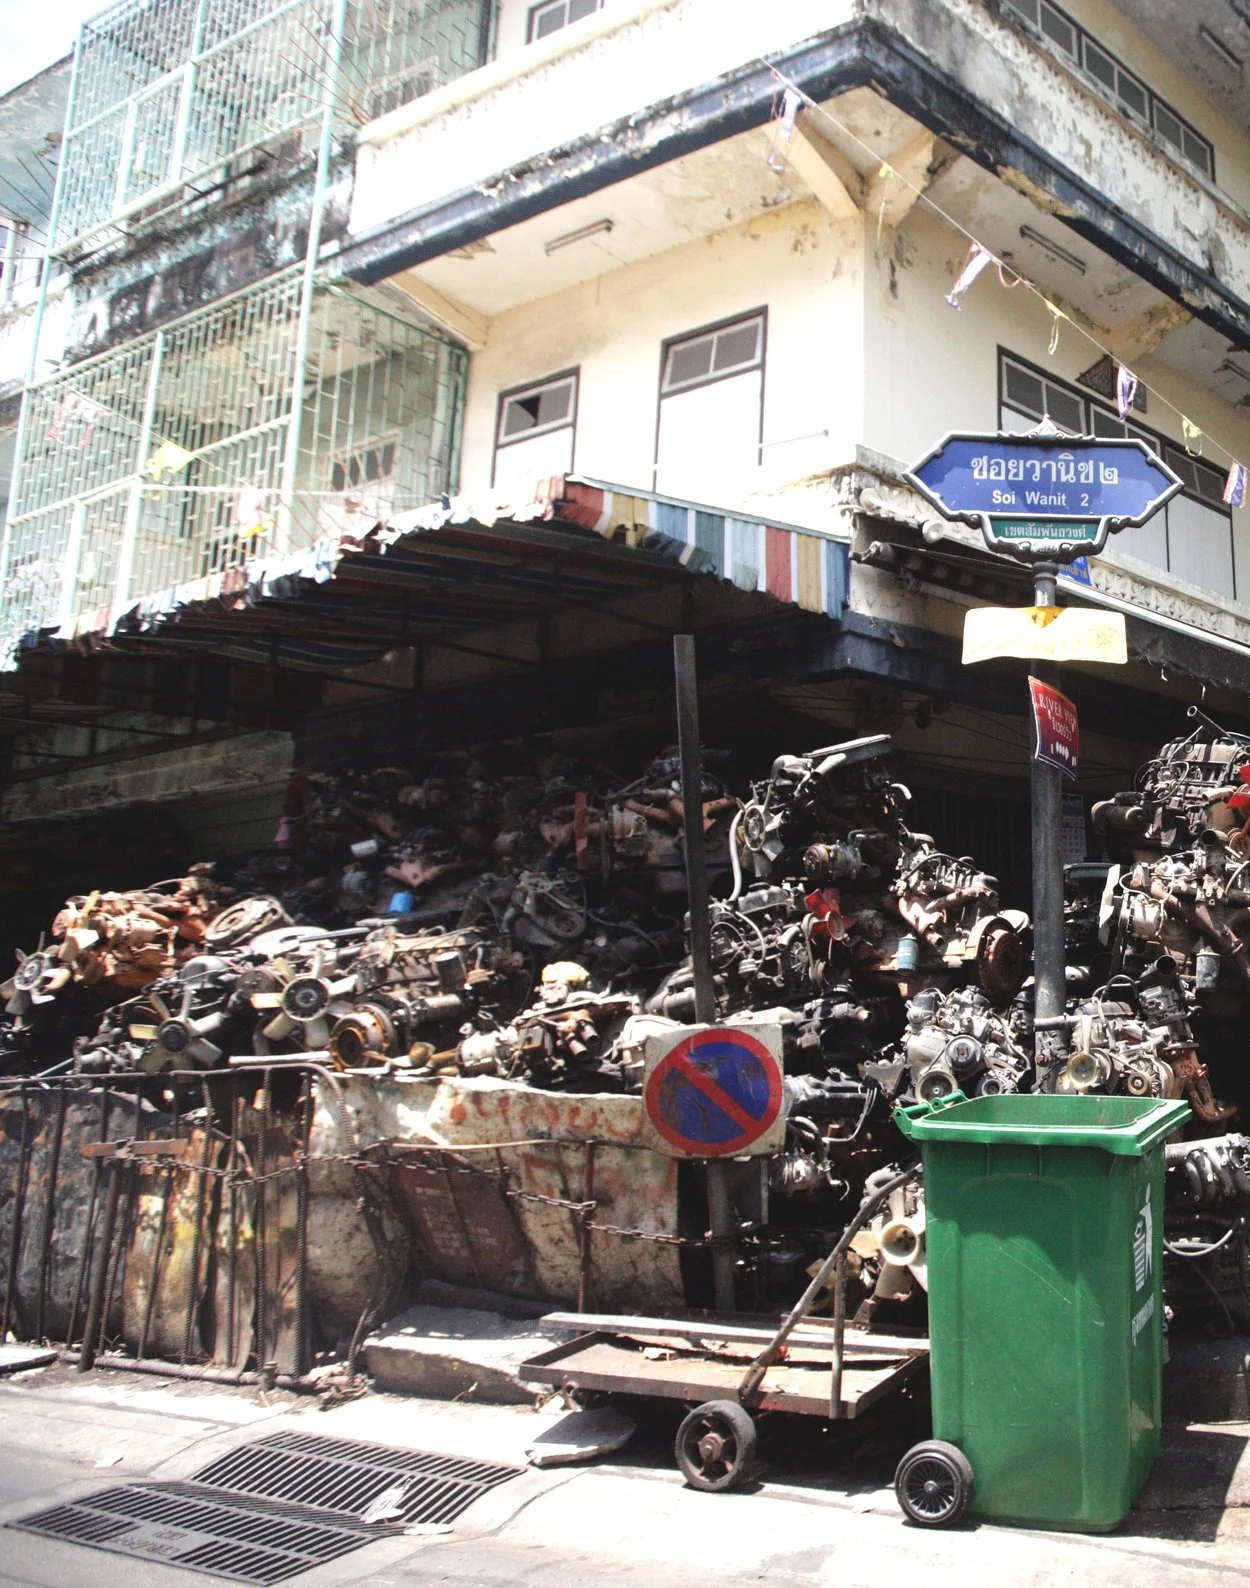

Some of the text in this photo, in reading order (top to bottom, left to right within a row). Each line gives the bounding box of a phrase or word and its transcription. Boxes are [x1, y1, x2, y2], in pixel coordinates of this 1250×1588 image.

[992, 490, 1089, 507] Soi Wanit 2
[1038, 693, 1063, 718] RIVER
